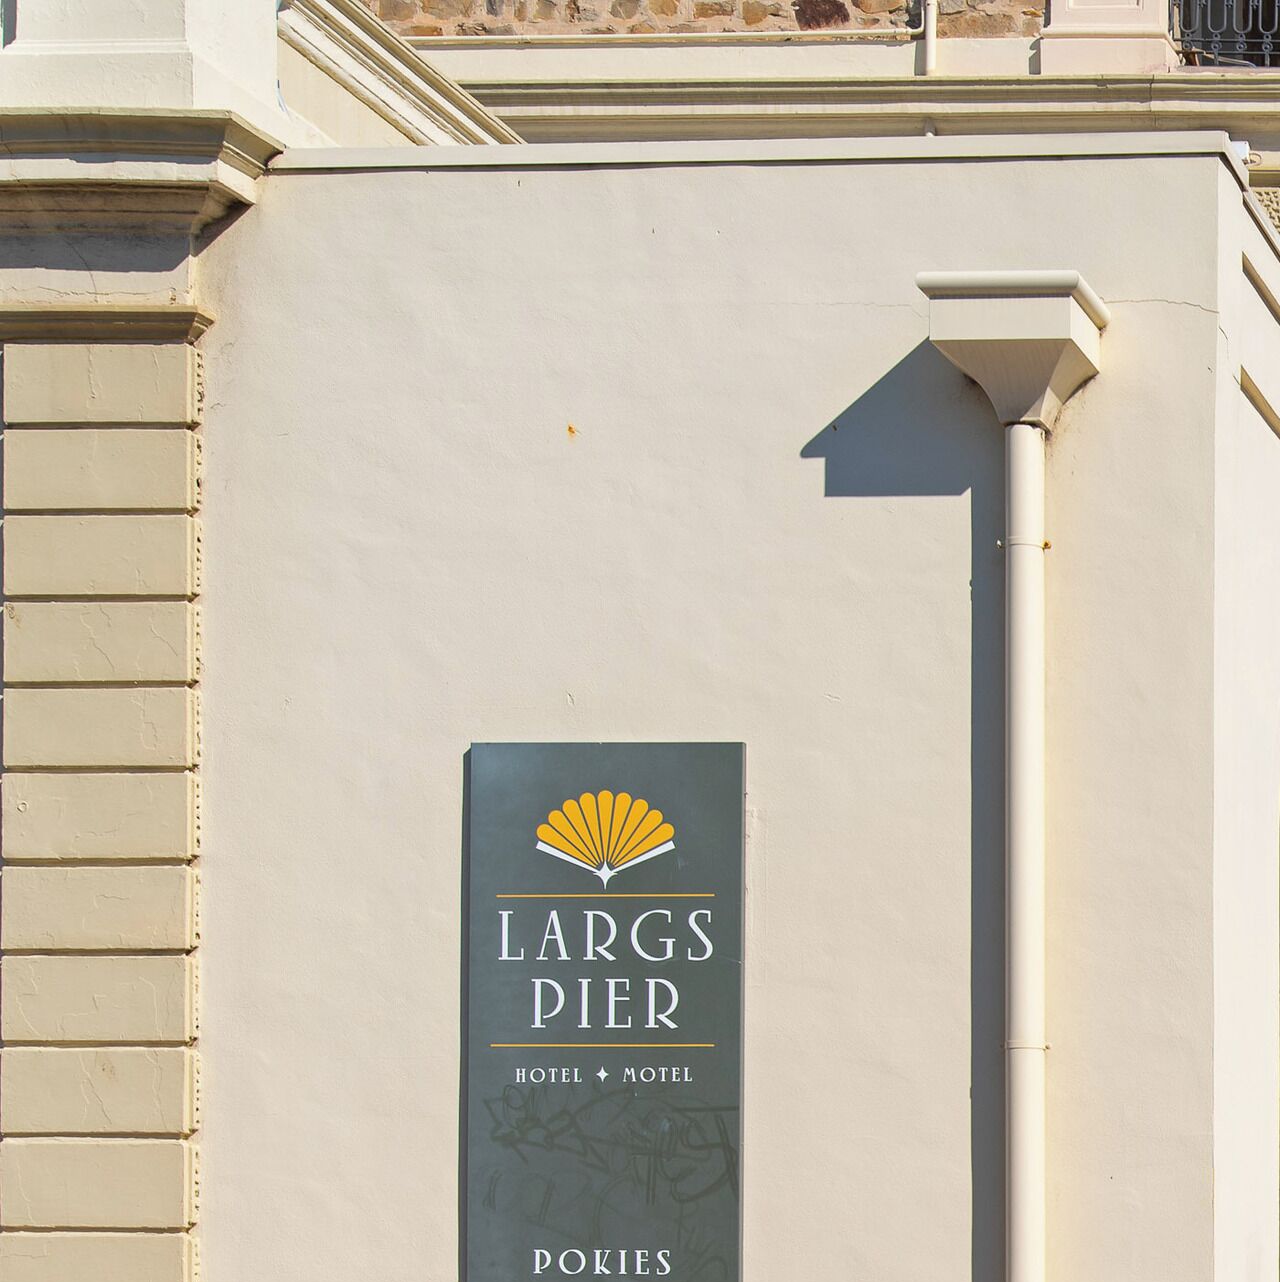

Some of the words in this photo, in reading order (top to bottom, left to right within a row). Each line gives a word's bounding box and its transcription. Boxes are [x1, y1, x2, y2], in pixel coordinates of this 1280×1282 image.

[498, 909, 713, 962] LARGS
[531, 978, 680, 1029] PIER
[515, 1067, 583, 1083] HOTEL
[622, 1066, 693, 1083] MOTEL
[533, 1249, 671, 1275] POKIES
